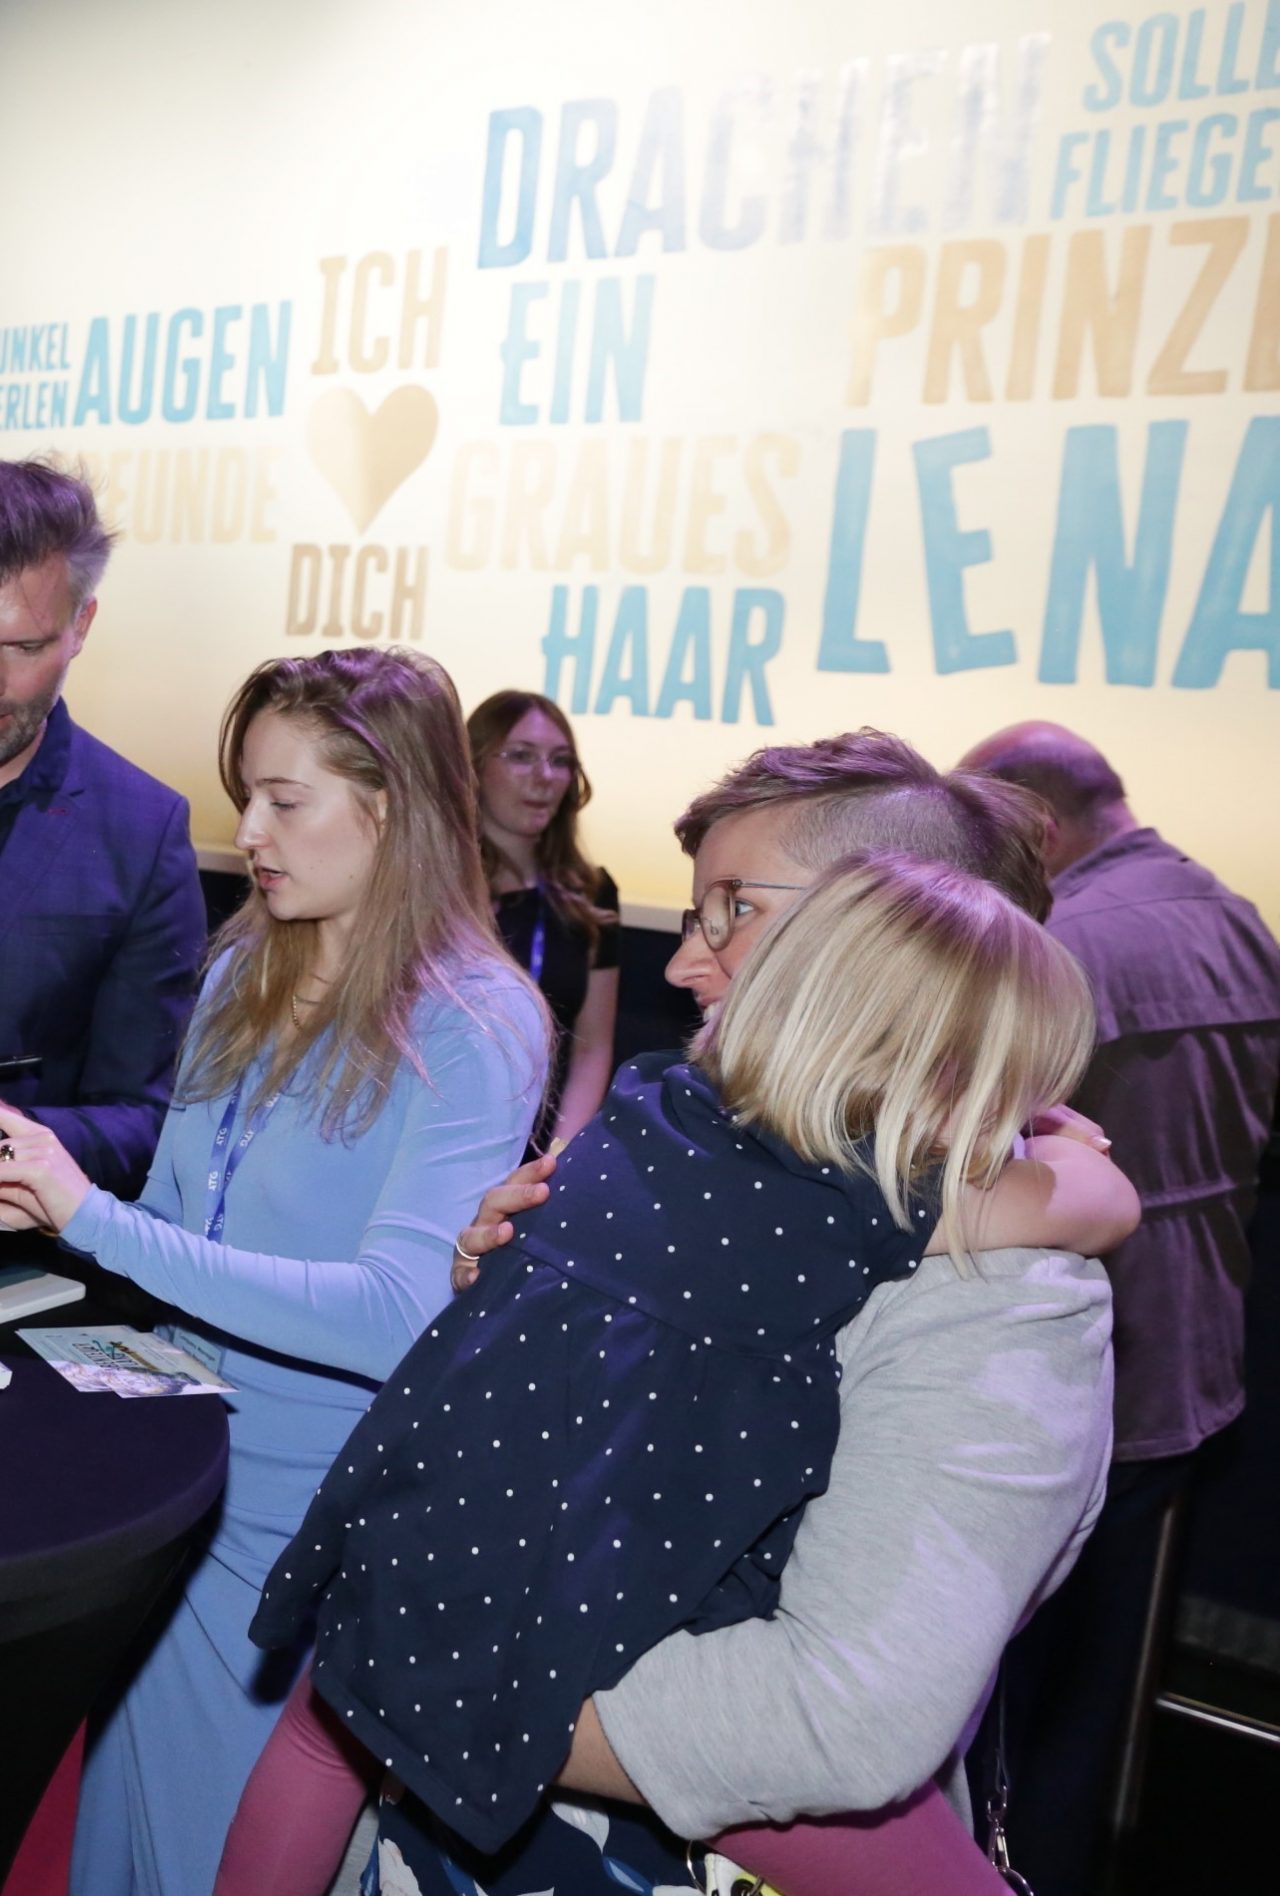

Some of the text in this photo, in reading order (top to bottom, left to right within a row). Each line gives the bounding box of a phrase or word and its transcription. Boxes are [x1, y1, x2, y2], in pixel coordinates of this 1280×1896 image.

[477, 34, 1051, 269] DRACHEN
[73, 301, 292, 426] AUGEN
[311, 246, 448, 376] ICH
[499, 273, 656, 426] EIN
[53, 447, 285, 544] EUNDE
[445, 432, 802, 578] GRAUES
[816, 415, 1280, 690] LENA
[285, 543, 429, 640] DICH
[542, 583, 786, 726] HAAR
[208, 1170, 219, 1192] ATG
